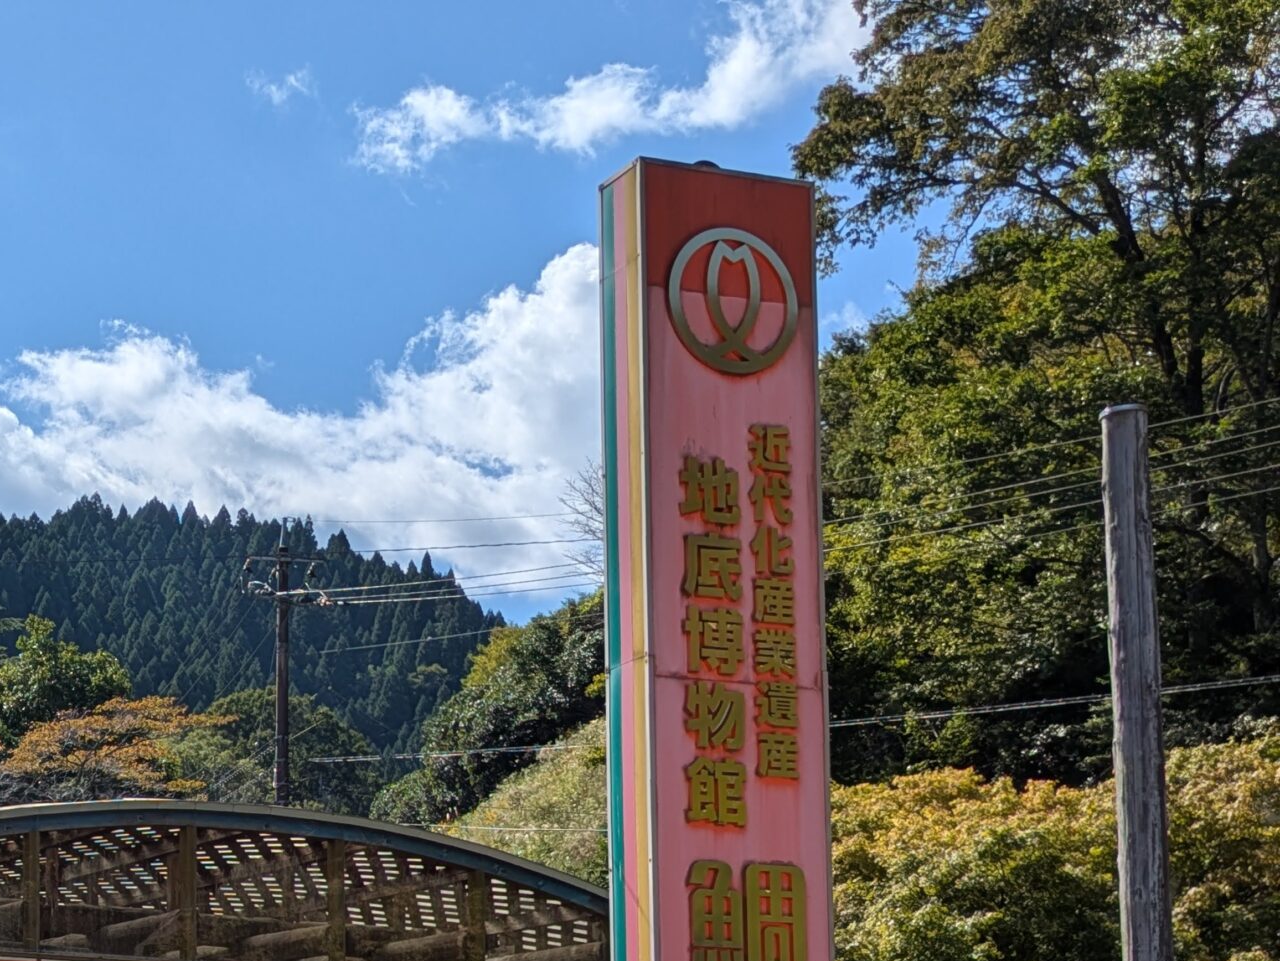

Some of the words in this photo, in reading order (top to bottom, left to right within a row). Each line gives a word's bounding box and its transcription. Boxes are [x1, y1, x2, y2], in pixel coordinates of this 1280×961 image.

[679, 456, 748, 828] 地底博物館
[748, 423, 799, 780] 近代化産業遺産
